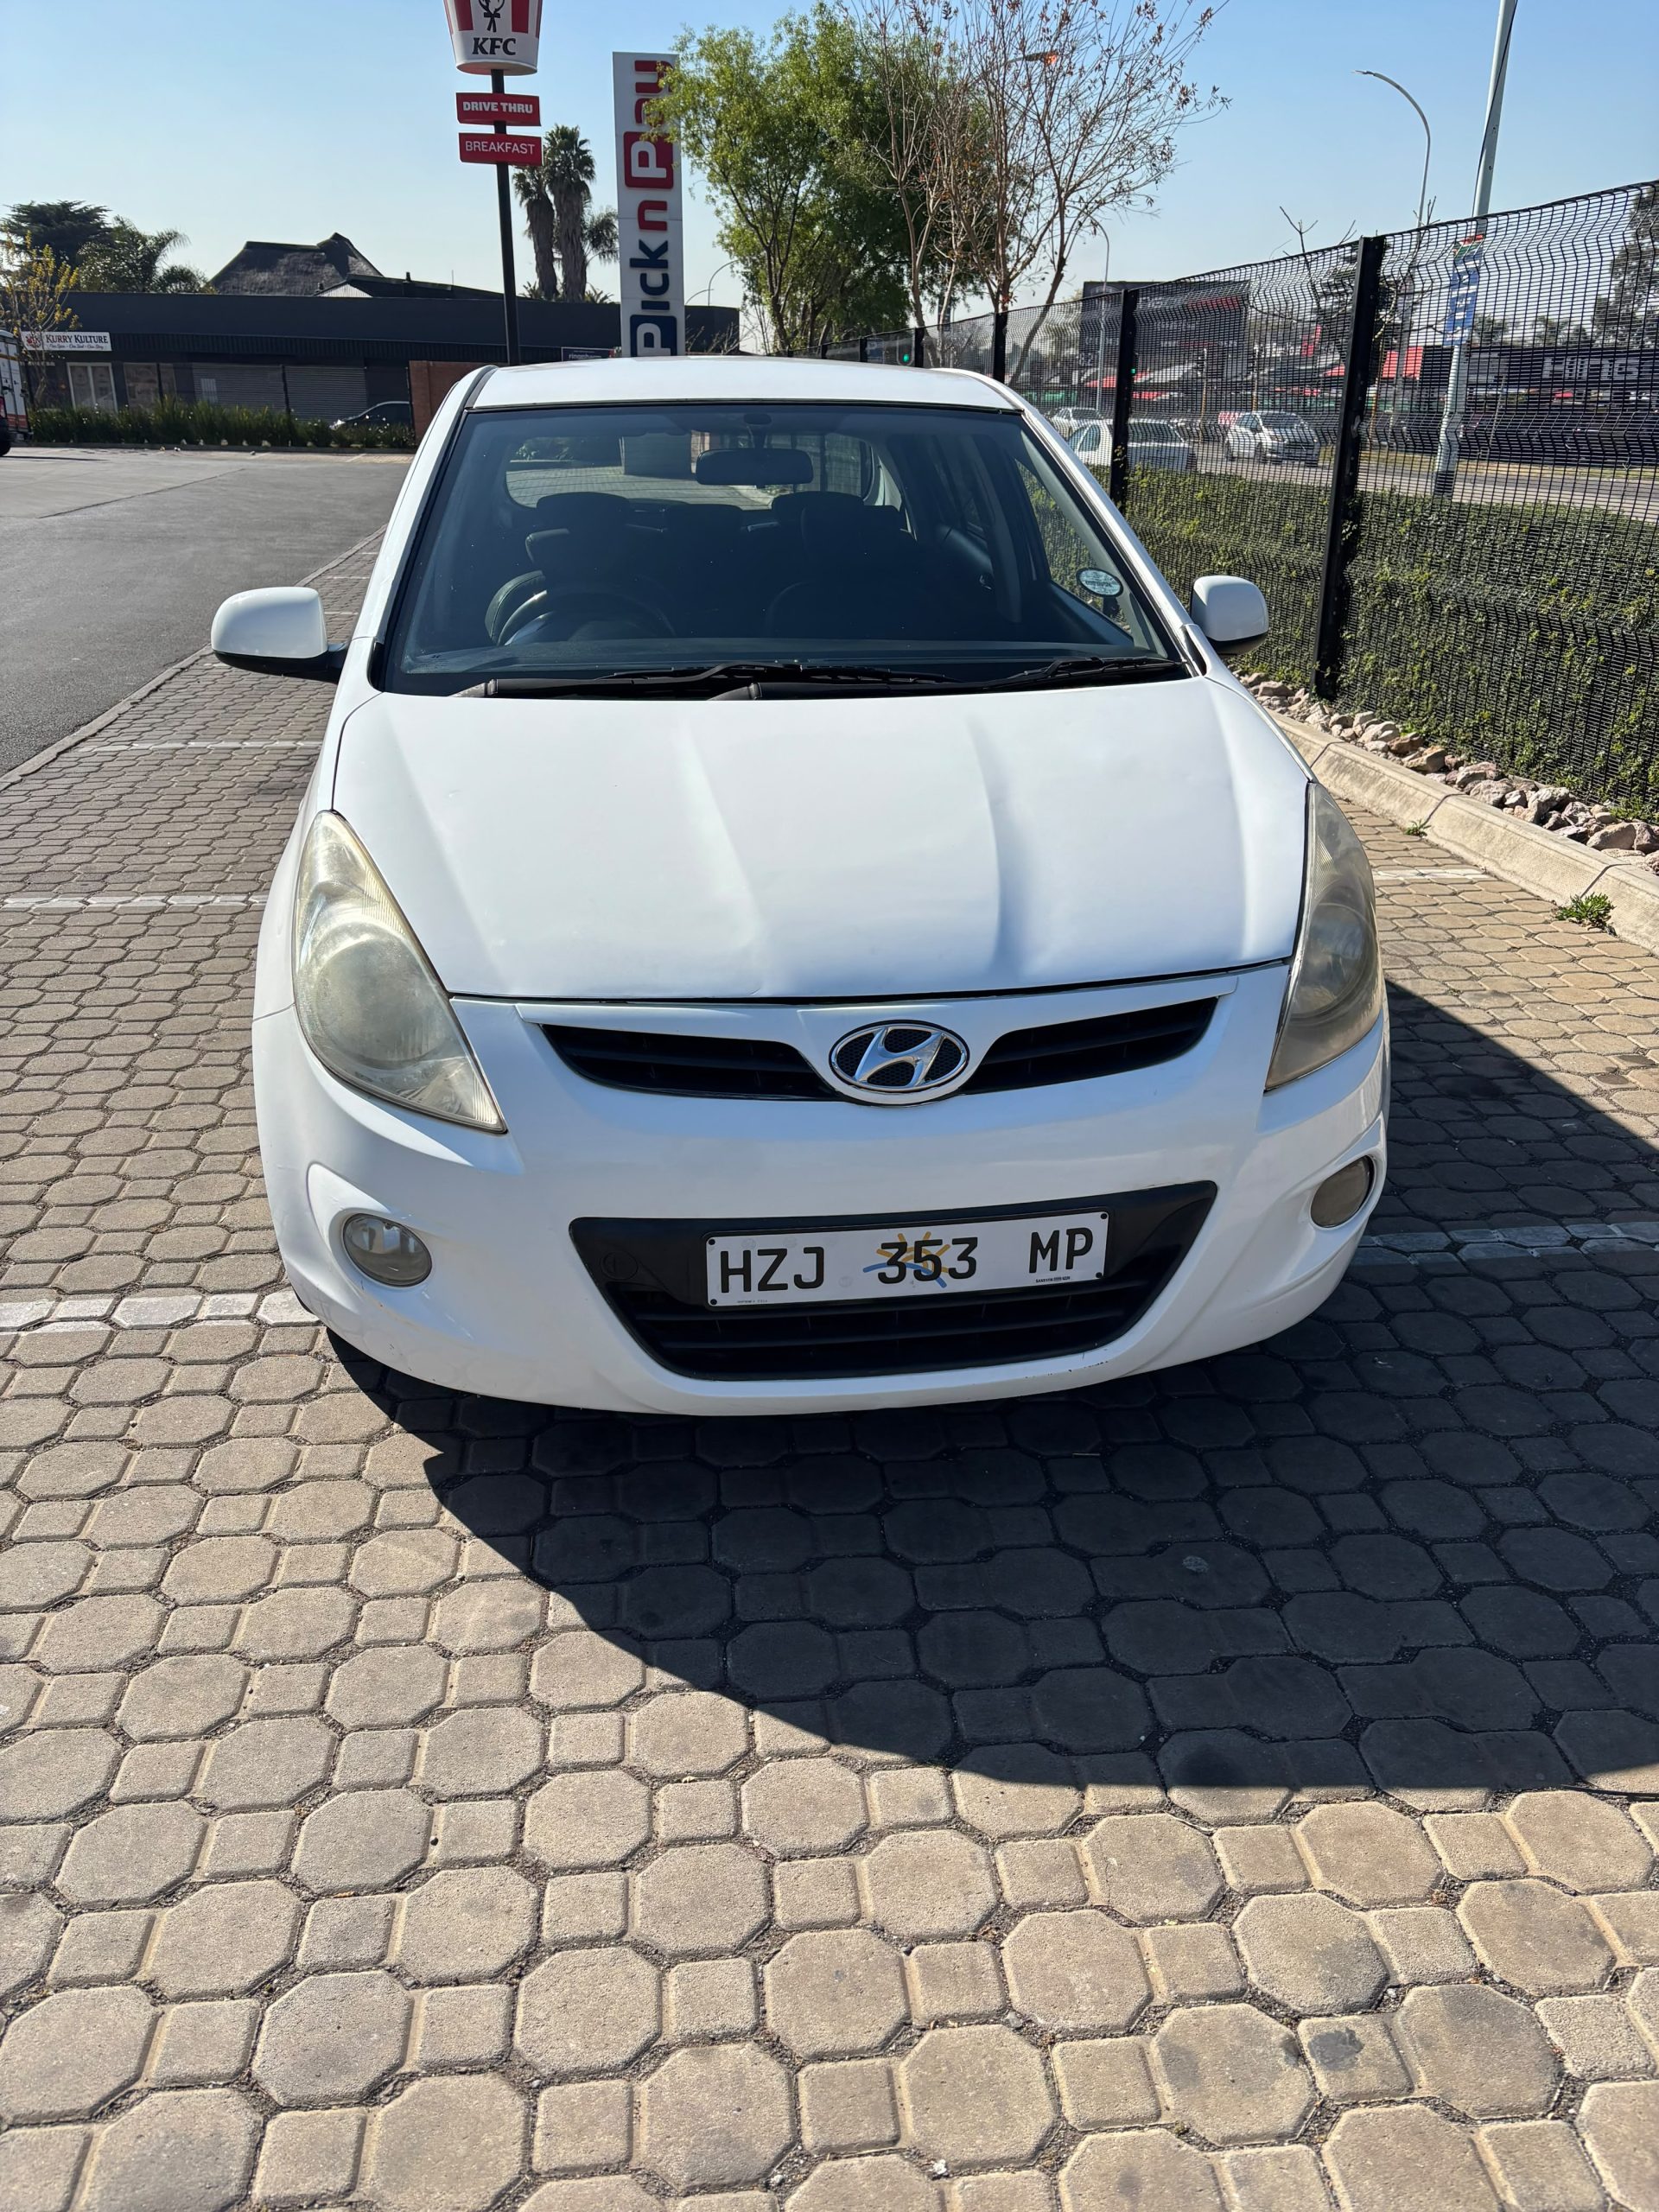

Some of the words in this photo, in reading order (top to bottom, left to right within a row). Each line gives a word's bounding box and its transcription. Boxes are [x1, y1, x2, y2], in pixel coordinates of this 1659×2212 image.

[472, 37, 517, 56] KFC
[462, 101, 499, 113] DRIVE
[501, 102, 533, 114] THRU
[465, 141, 535, 156] BREAKFAST
[638, 200, 668, 231] n
[630, 239, 675, 356] Pick
[45, 334, 73, 344] KURRY
[74, 334, 108, 345] KULTURE
[720, 1246, 824, 1294] HZJ
[877, 1236, 978, 1285] 353
[1029, 1227, 1093, 1274] MP
